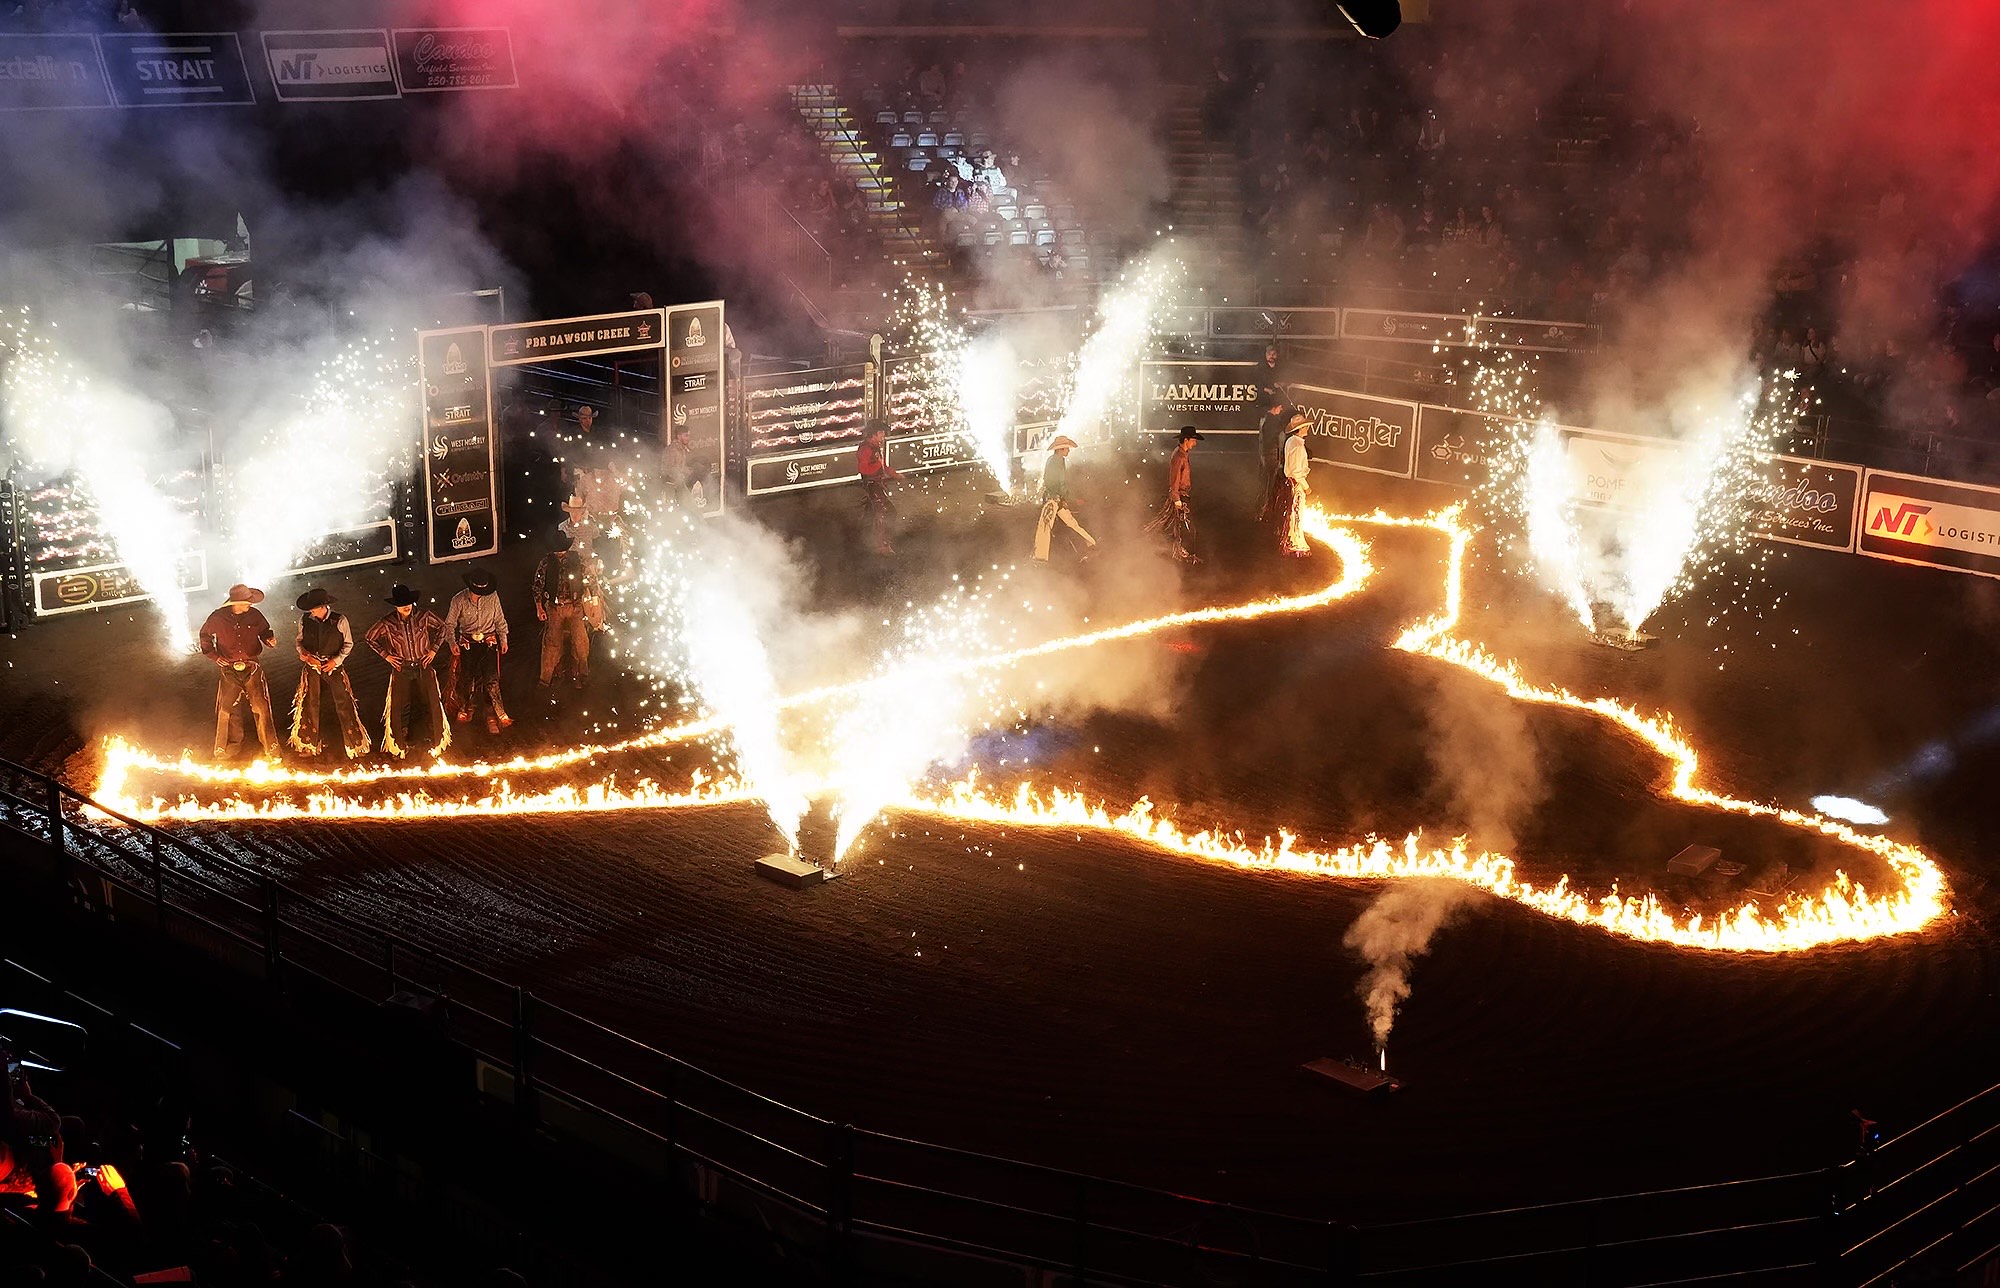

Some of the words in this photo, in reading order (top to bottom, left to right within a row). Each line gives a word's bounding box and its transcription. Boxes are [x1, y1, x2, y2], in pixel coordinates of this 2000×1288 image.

[413, 34, 496, 65] Candoo
[136, 60, 214, 80] STRAIT
[281, 53, 317, 80] NT
[327, 65, 386, 75] LOGISTICS
[525, 336, 547, 348] PBR
[550, 331, 595, 346] DAWSON
[597, 327, 631, 341] CREEK
[684, 378, 706, 388] STRAIT
[1152, 384, 1258, 401] LAMMLE'S
[445, 409, 471, 420] STRAIT
[1167, 403, 1211, 412] WESTERN
[1214, 404, 1241, 412] WEAR
[1297, 405, 1402, 453] Wrangler
[451, 440, 463, 448] WEST
[1812, 519, 1835, 533] Inc.
[1870, 503, 1932, 536] NT
